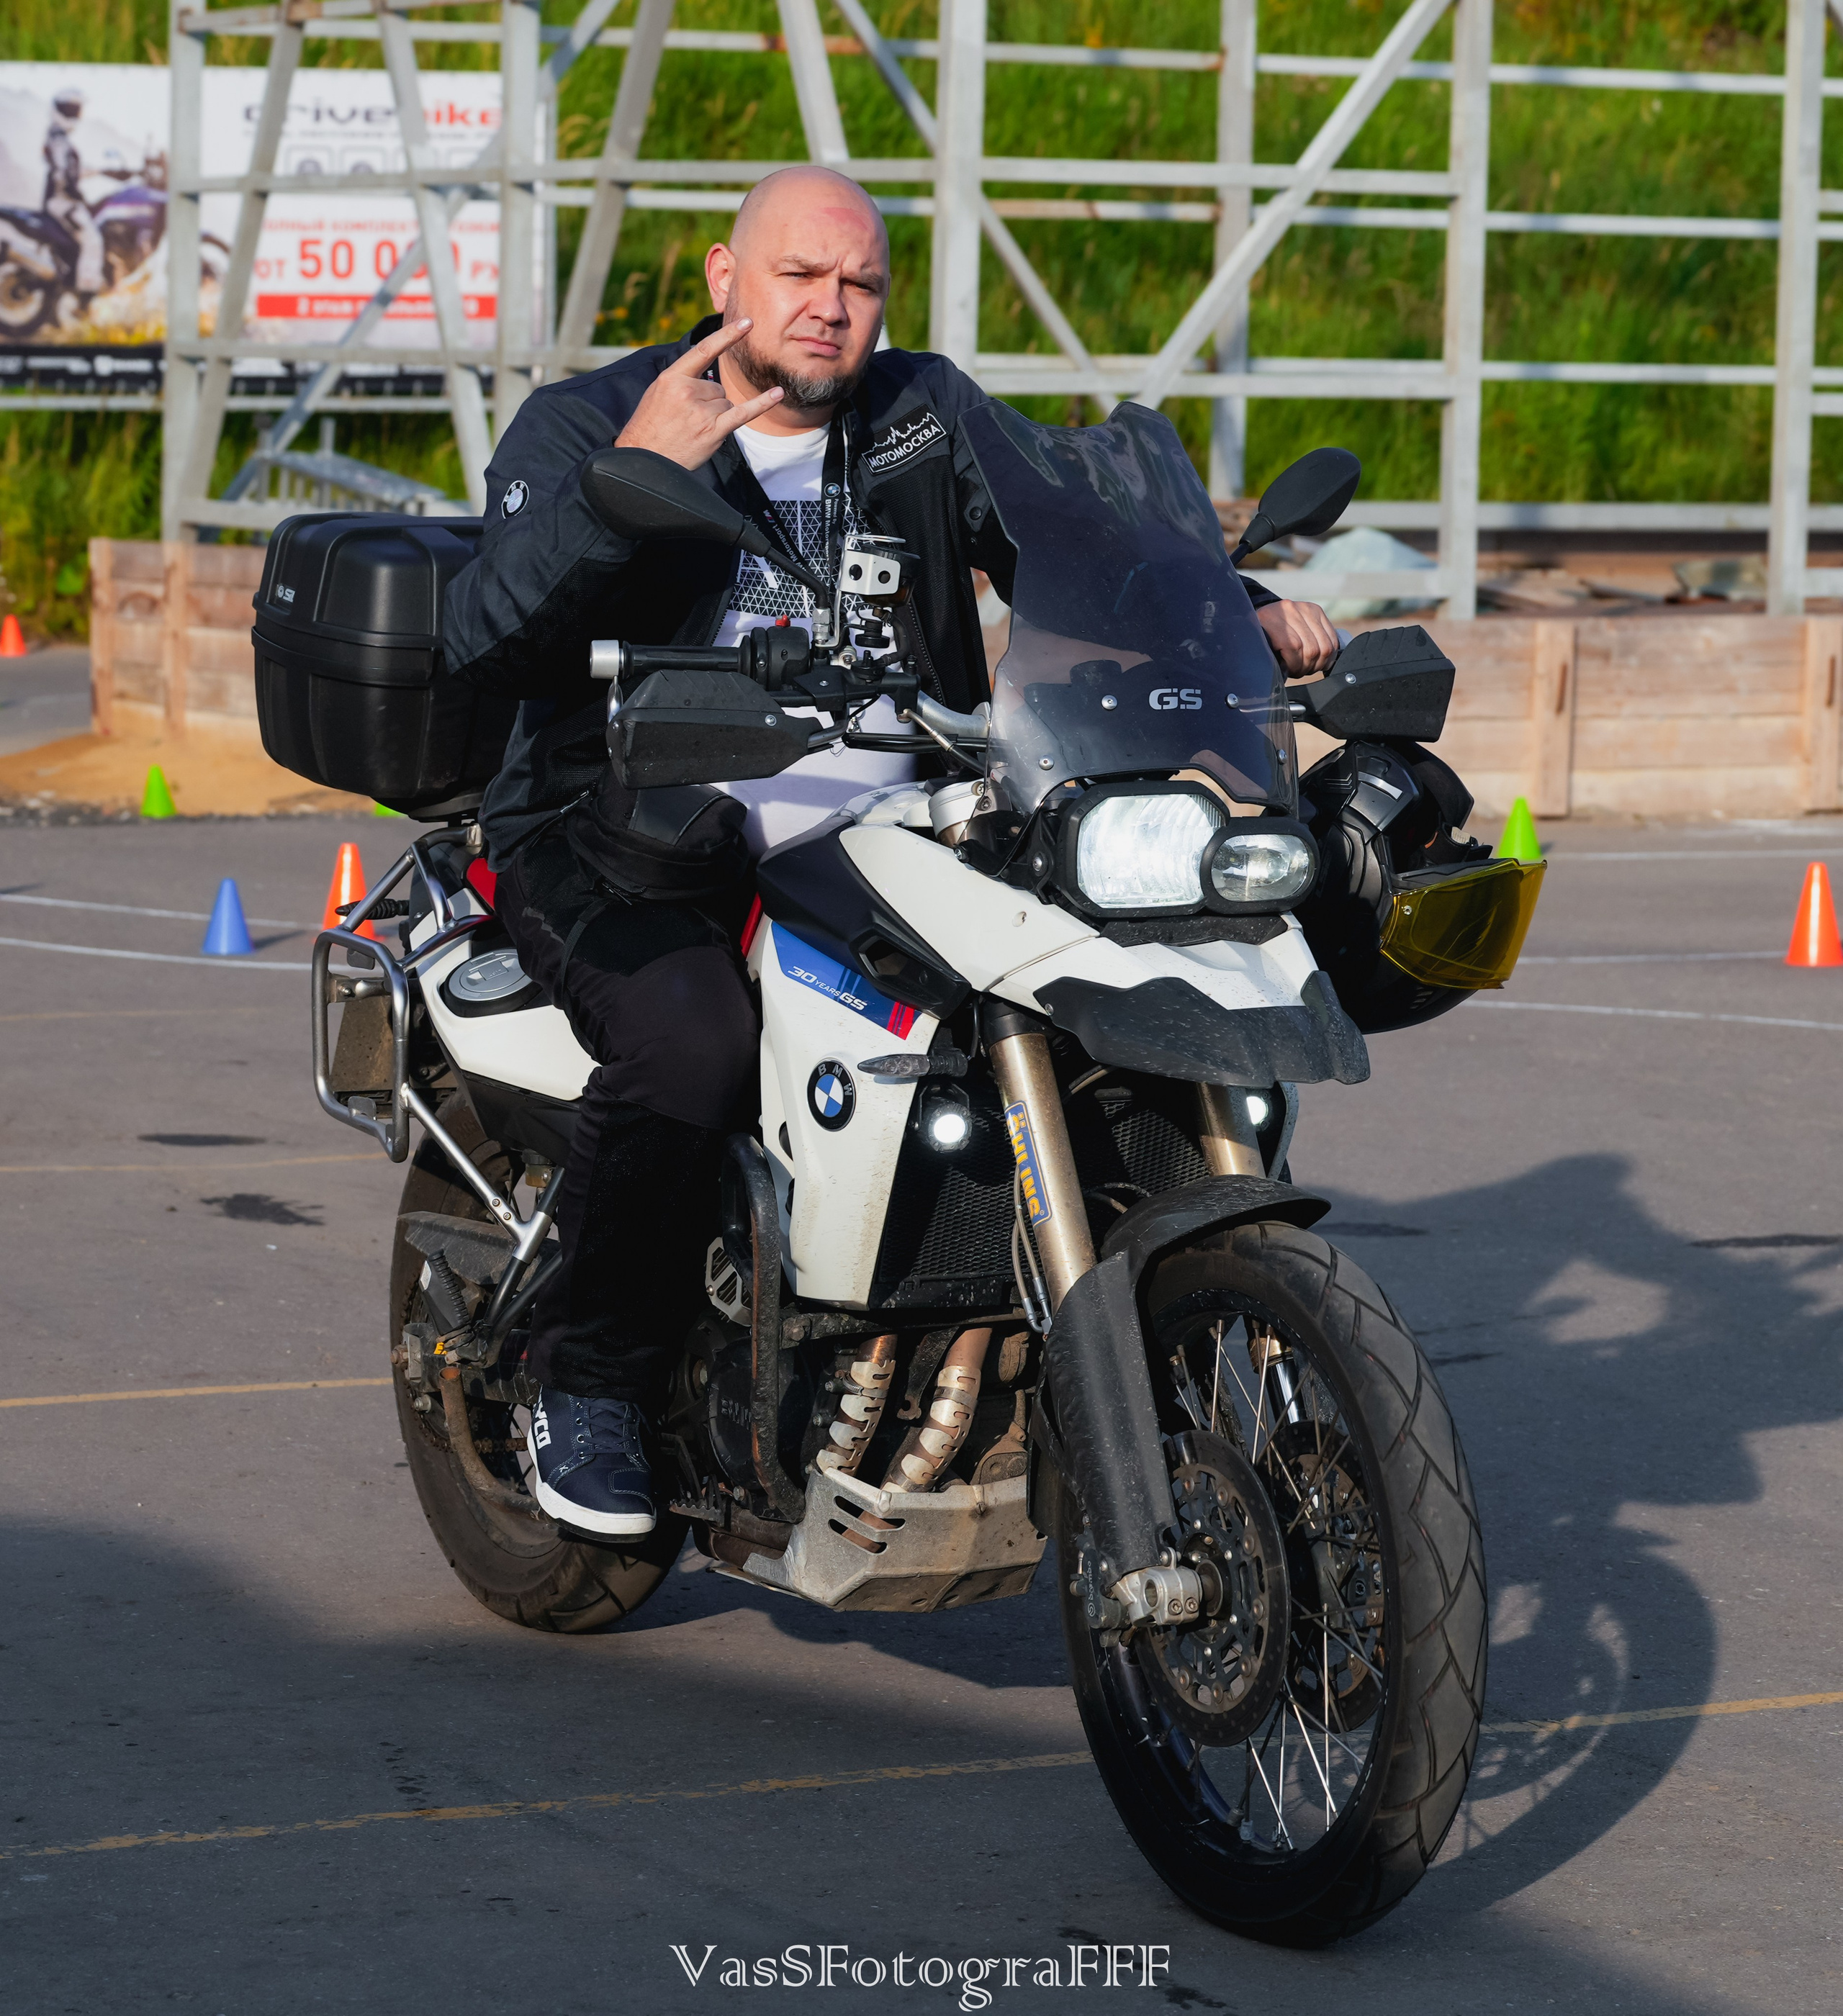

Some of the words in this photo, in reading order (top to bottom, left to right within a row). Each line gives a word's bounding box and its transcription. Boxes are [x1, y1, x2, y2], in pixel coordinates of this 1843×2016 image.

[299, 239, 354, 279] 50
[868, 424, 941, 468] МОТОМОСКВА
[772, 524, 798, 562] Motorsport
[1148, 688, 1203, 710] GS
[788, 966, 817, 983] 30
[814, 980, 841, 997] YEARS
[839, 992, 868, 1011] GS
[818, 1063, 852, 1096] BMW
